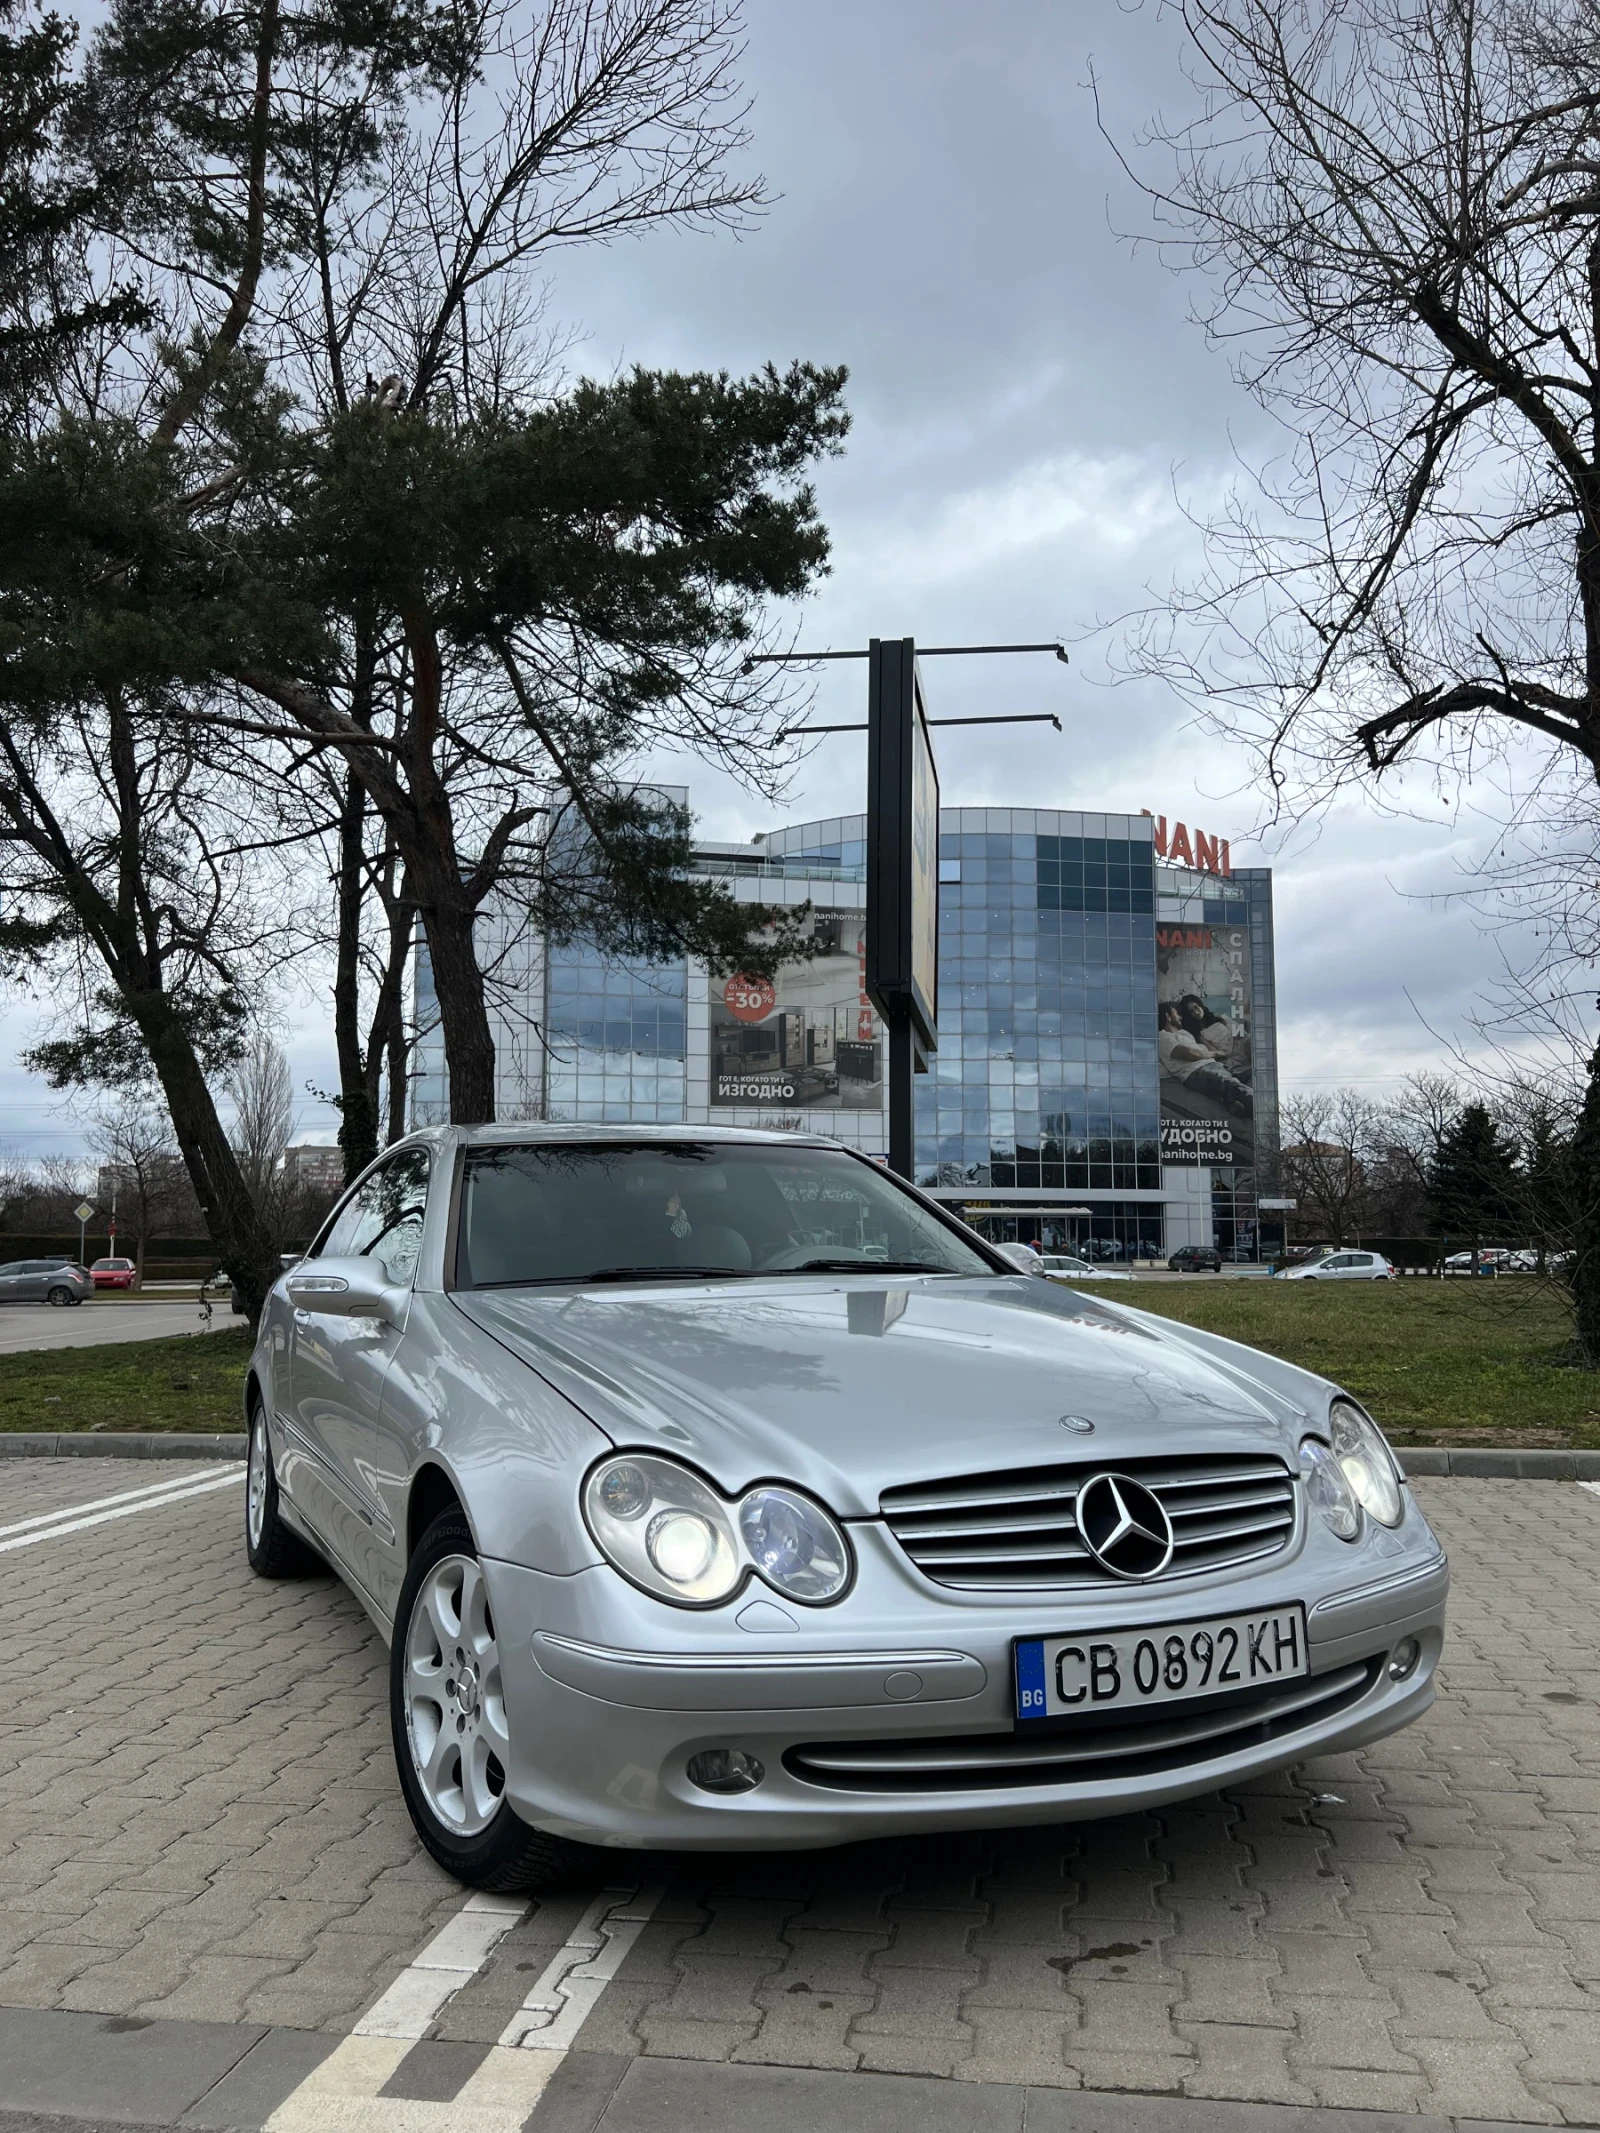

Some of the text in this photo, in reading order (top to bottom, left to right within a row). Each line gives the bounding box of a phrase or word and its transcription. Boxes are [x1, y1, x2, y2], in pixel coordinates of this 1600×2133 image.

[1140, 808, 1230, 878] NANI
[1156, 929, 1212, 949] NANI
[1229, 933, 1245, 1037] СПАЛНИ
[719, 1075, 732, 1083] ГОТ
[740, 1076, 770, 1084] КОГАТО
[718, 1084, 795, 1099] ИЗГОДНО
[1212, 1120, 1223, 1128] ТИ
[1161, 1128, 1232, 1145] УДОБНО
[1055, 1615, 1298, 1704] CB 0892 KH
[1022, 1689, 1043, 1708] BG
